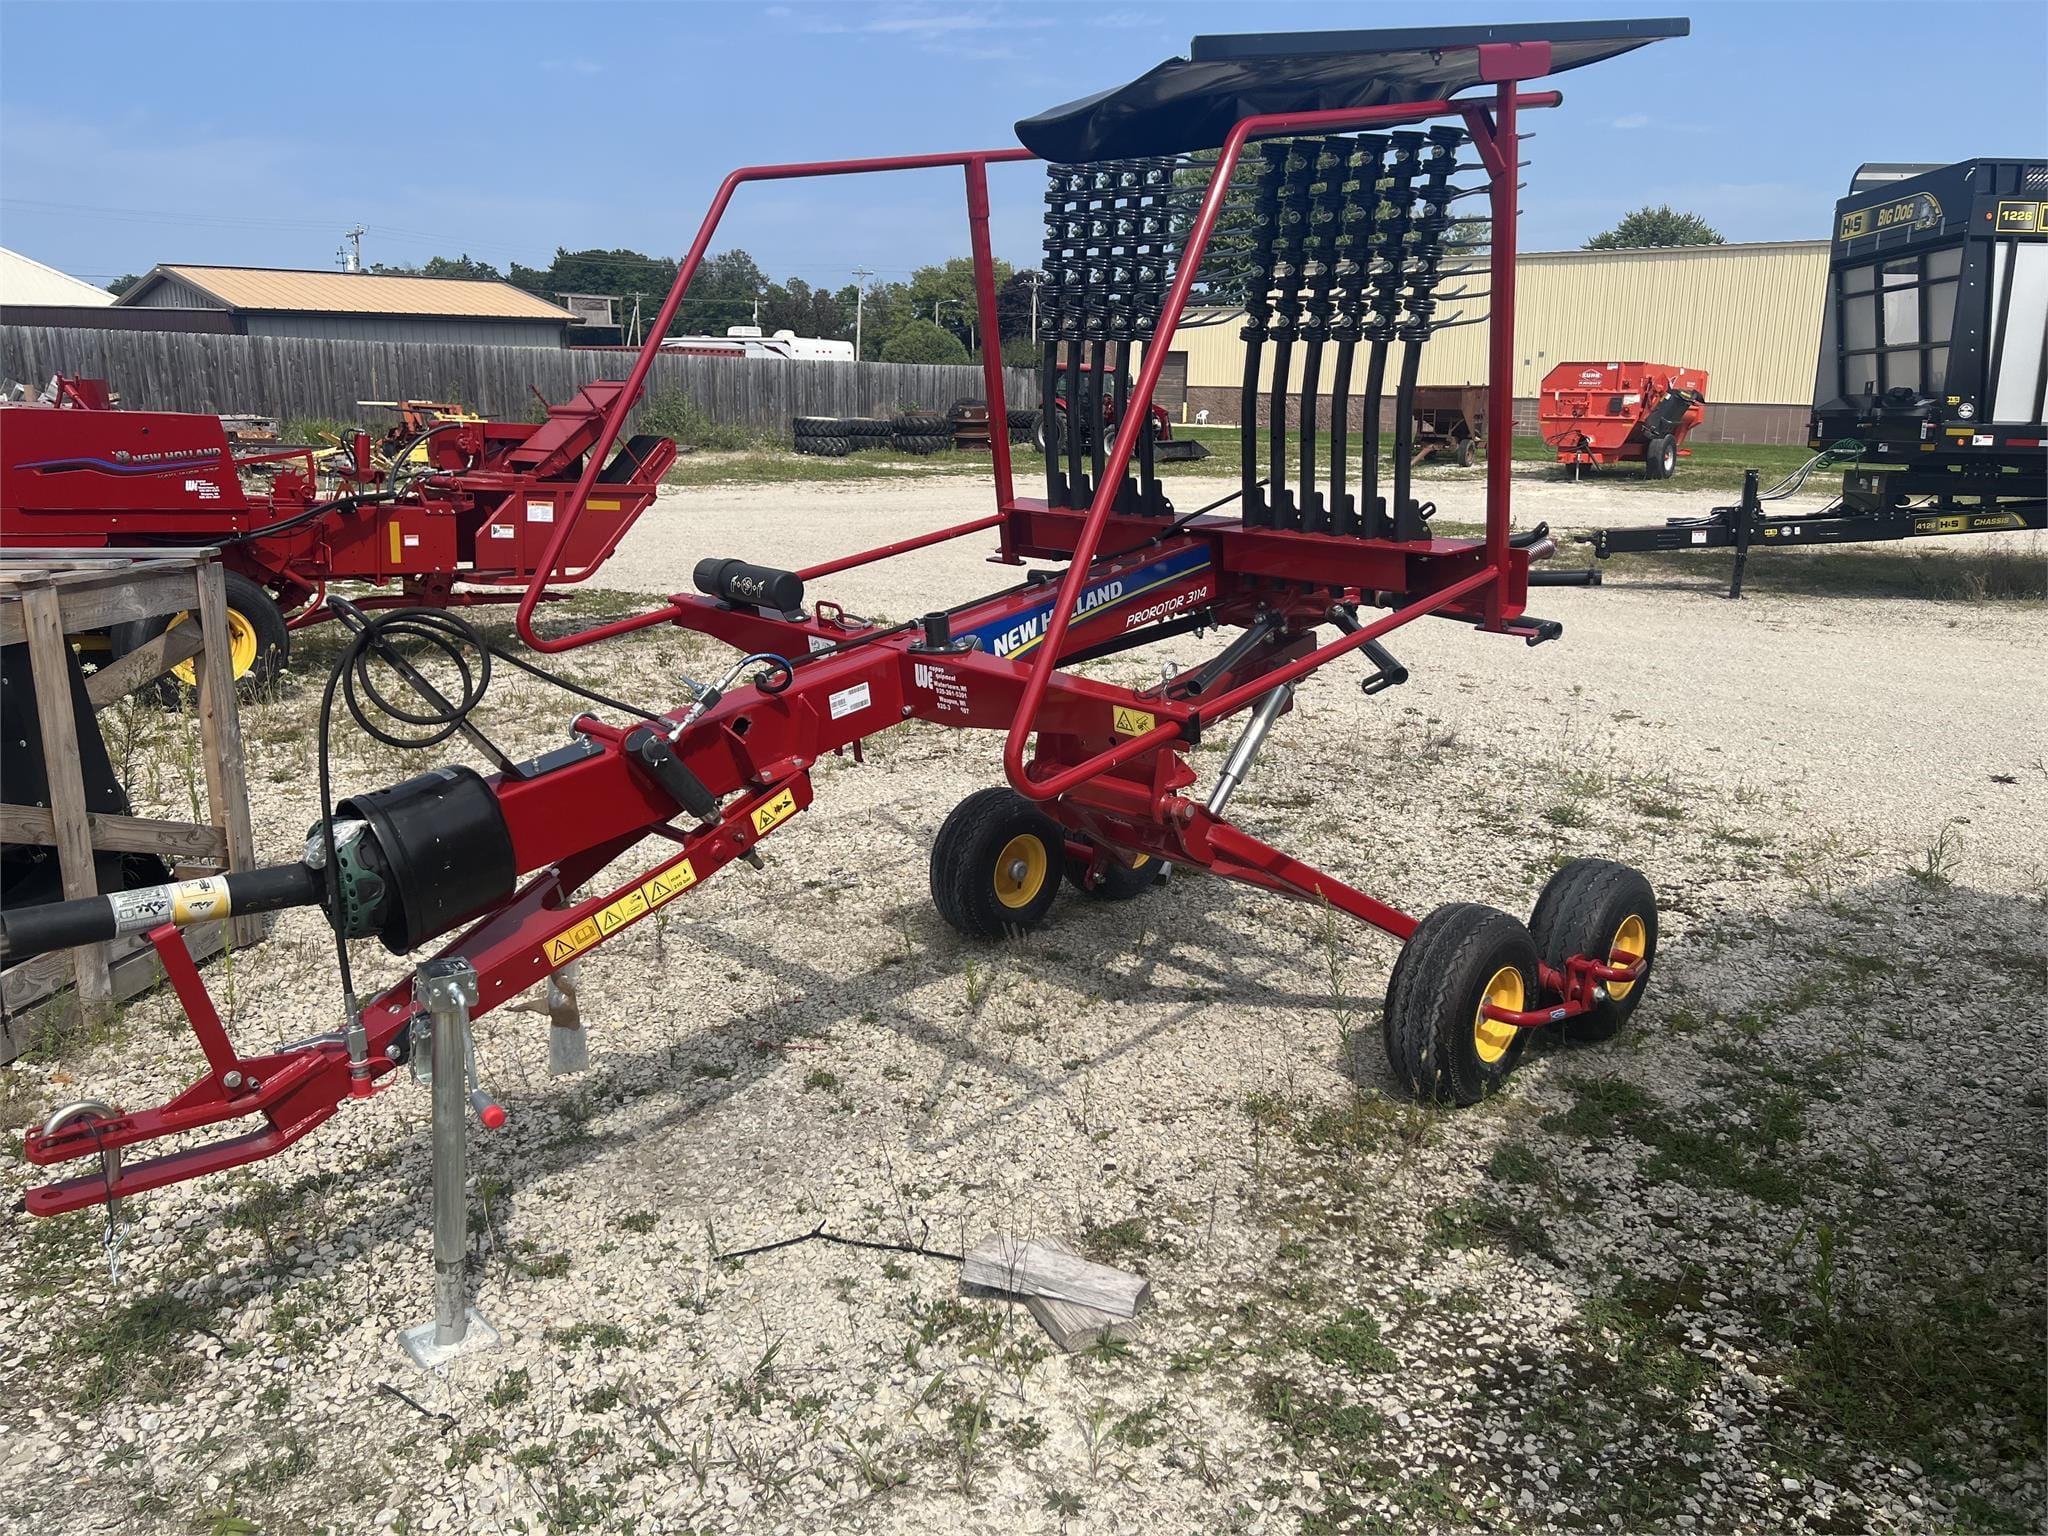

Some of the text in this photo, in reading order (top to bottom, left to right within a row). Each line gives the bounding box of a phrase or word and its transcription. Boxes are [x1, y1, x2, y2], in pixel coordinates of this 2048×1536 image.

[1877, 208, 1894, 226] BIG
[1894, 203, 1915, 222] DOG
[2002, 210, 2033, 221] 1226
[132, 447, 221, 463] NEW HOLLAND
[1973, 517, 2010, 526] CHASSIS
[1126, 586, 1208, 627] PROROTOR 3114
[993, 580, 1123, 657] NEW HLLAND
